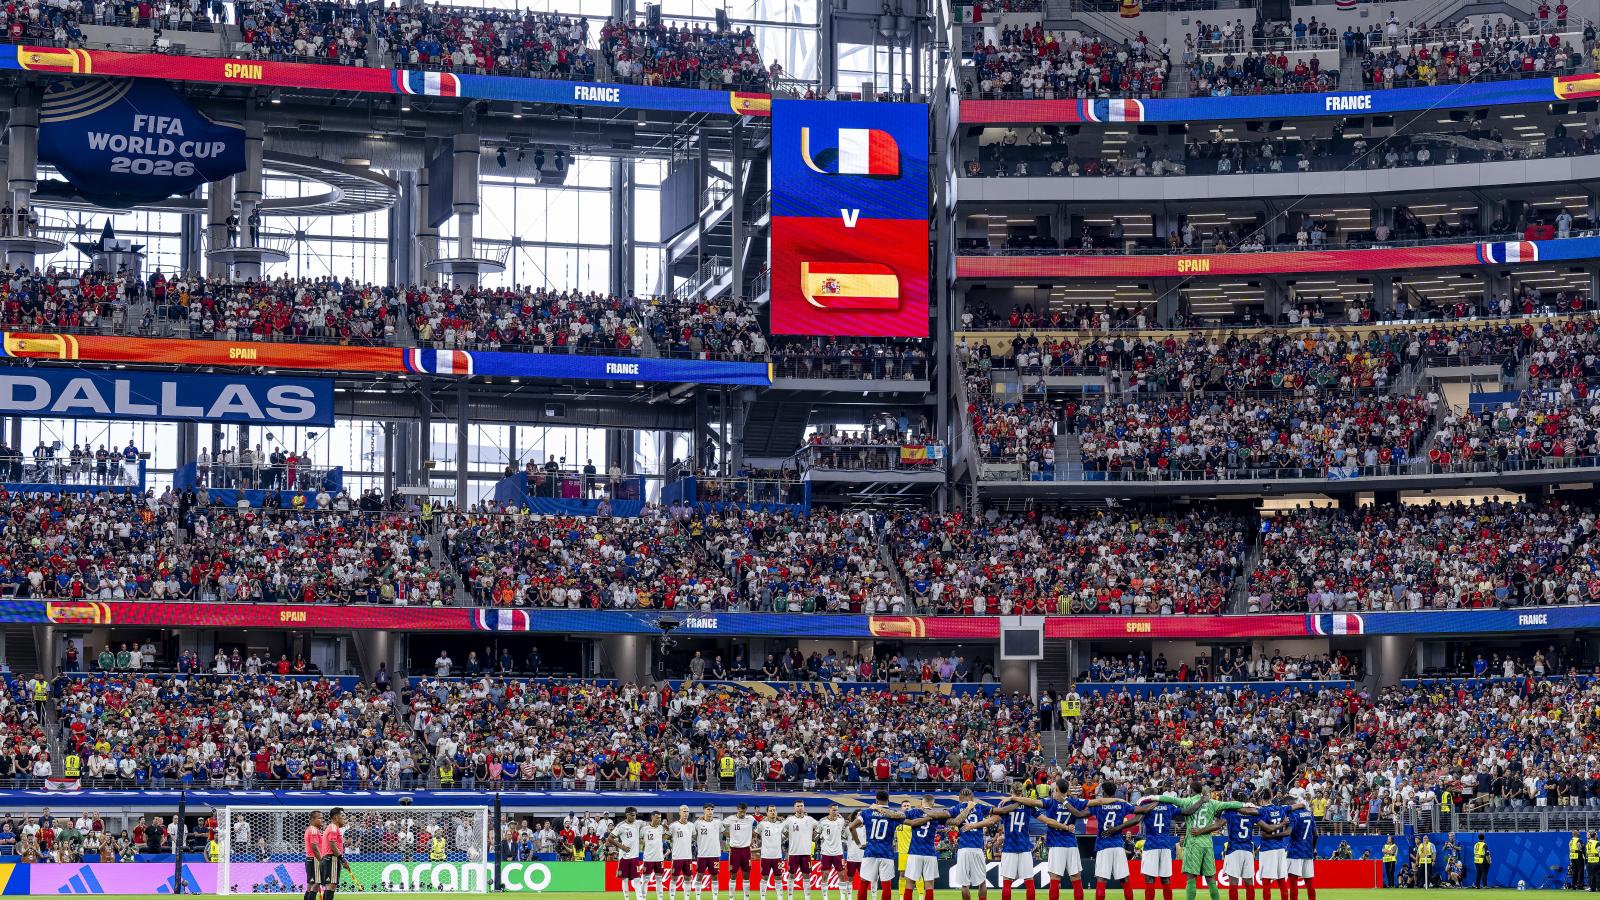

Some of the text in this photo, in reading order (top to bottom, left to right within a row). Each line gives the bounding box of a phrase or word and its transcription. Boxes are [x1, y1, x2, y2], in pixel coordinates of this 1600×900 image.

[224, 63, 263, 80] SPAIN
[574, 86, 620, 103] FRANCE
[1325, 94, 1372, 111] FRANCE
[133, 114, 184, 136] FIFA
[87, 131, 226, 159] WORLD CUP
[110, 157, 195, 177] 2026
[1177, 258, 1210, 274] SPAIN
[229, 347, 257, 360] SPAIN
[606, 362, 639, 376] FRANCE
[0, 375, 316, 421] DALLAS
[280, 610, 307, 622] SPAIN
[686, 617, 718, 629] FRANCE
[1518, 614, 1548, 625] FRANCE
[1126, 622, 1151, 633] SPAIN
[1008, 811, 1025, 833] 14
[1056, 811, 1072, 825] 17
[1103, 811, 1117, 831] 8
[1153, 813, 1165, 834] 4
[764, 829, 771, 837] 21
[870, 819, 889, 840] 10
[1238, 818, 1250, 839] 5
[1303, 819, 1311, 840] 7
[381, 862, 552, 891] aramco
